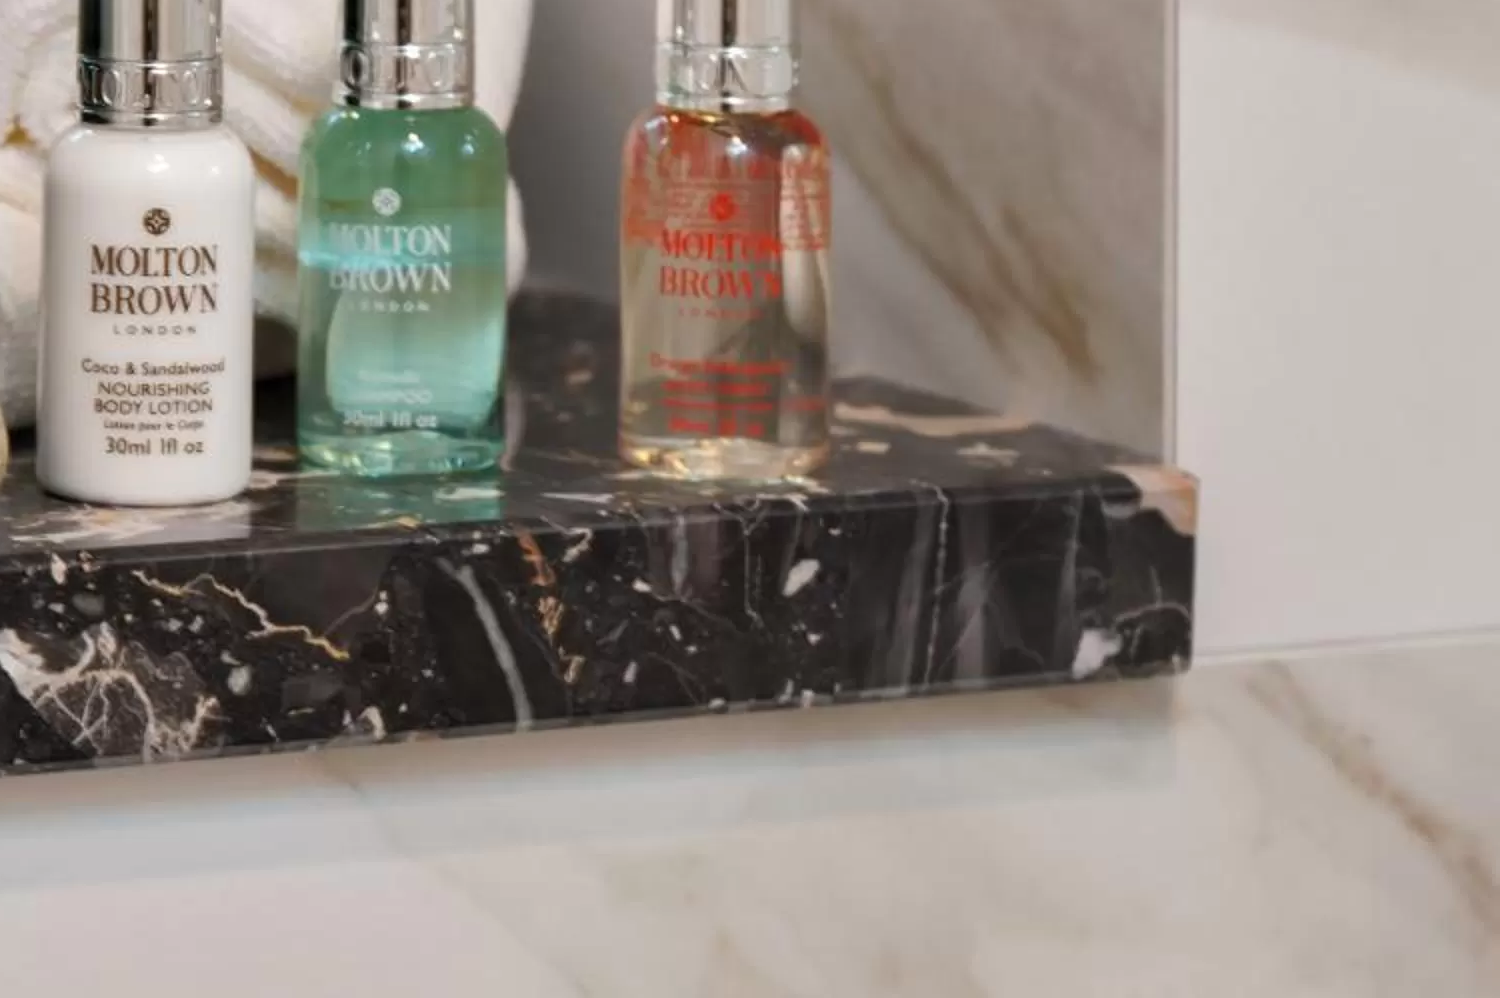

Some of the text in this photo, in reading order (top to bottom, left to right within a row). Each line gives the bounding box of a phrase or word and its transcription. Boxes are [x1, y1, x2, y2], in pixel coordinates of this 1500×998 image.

[90, 245, 218, 277] MOLTON
[329, 262, 452, 294] BROWN
[90, 282, 218, 315] BROWN
[348, 299, 430, 313] ONDON
[113, 324, 197, 335] LONDON
[81, 356, 226, 376] Coco & Sandalwood
[97, 381, 211, 397] NOURISHING
[94, 397, 213, 415] BODY LOTION
[105, 436, 152, 455] 30ml
[183, 440, 205, 454] oz
